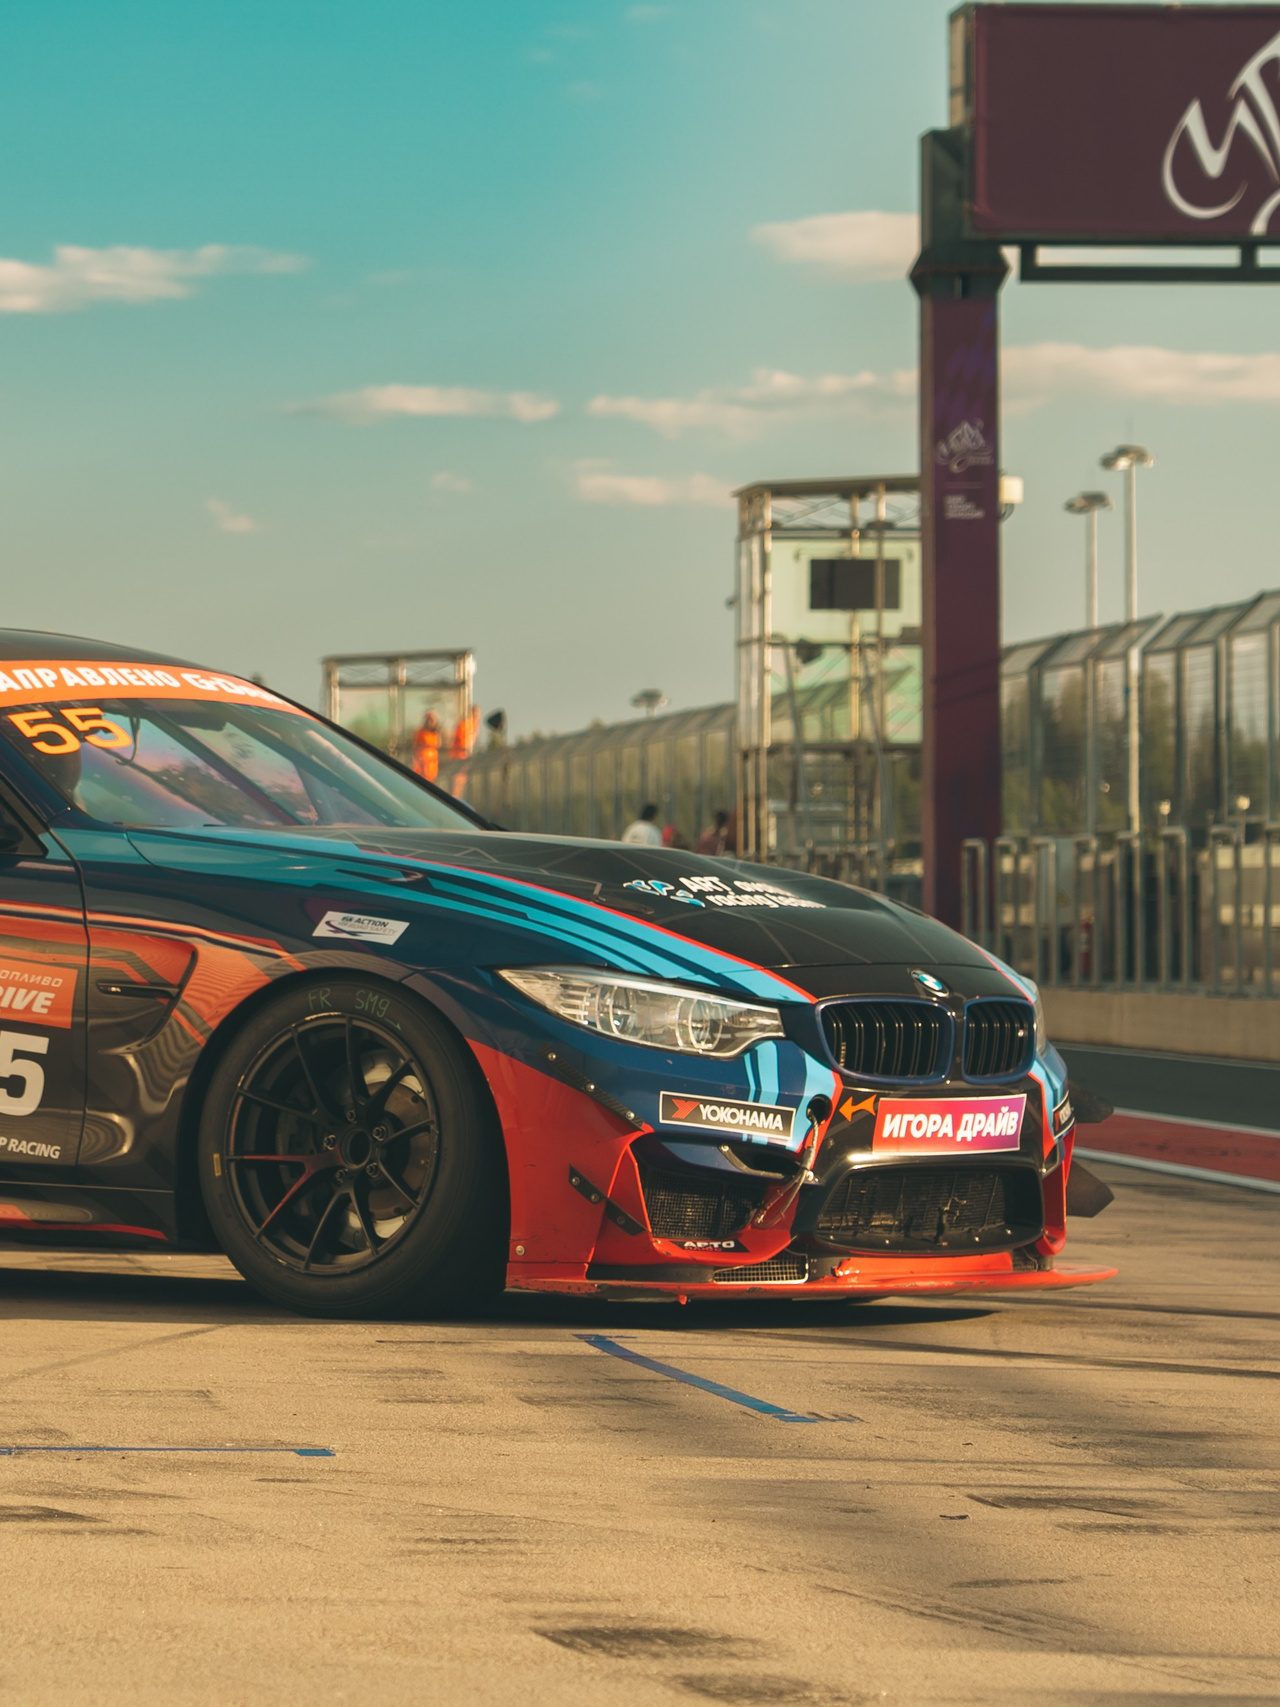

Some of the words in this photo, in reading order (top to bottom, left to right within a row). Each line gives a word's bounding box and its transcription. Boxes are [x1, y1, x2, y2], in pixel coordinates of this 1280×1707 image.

[7, 707, 133, 755] 55
[678, 876, 732, 893] ART
[705, 890, 779, 908] racing
[355, 917, 389, 928] ACTION
[308, 987, 332, 1010] FR
[699, 1103, 783, 1131] YOKOHAMA
[882, 1113, 953, 1138] ИГОРА
[956, 1106, 1019, 1142] ДРАЙВ
[7, 1138, 61, 1159] RACING
